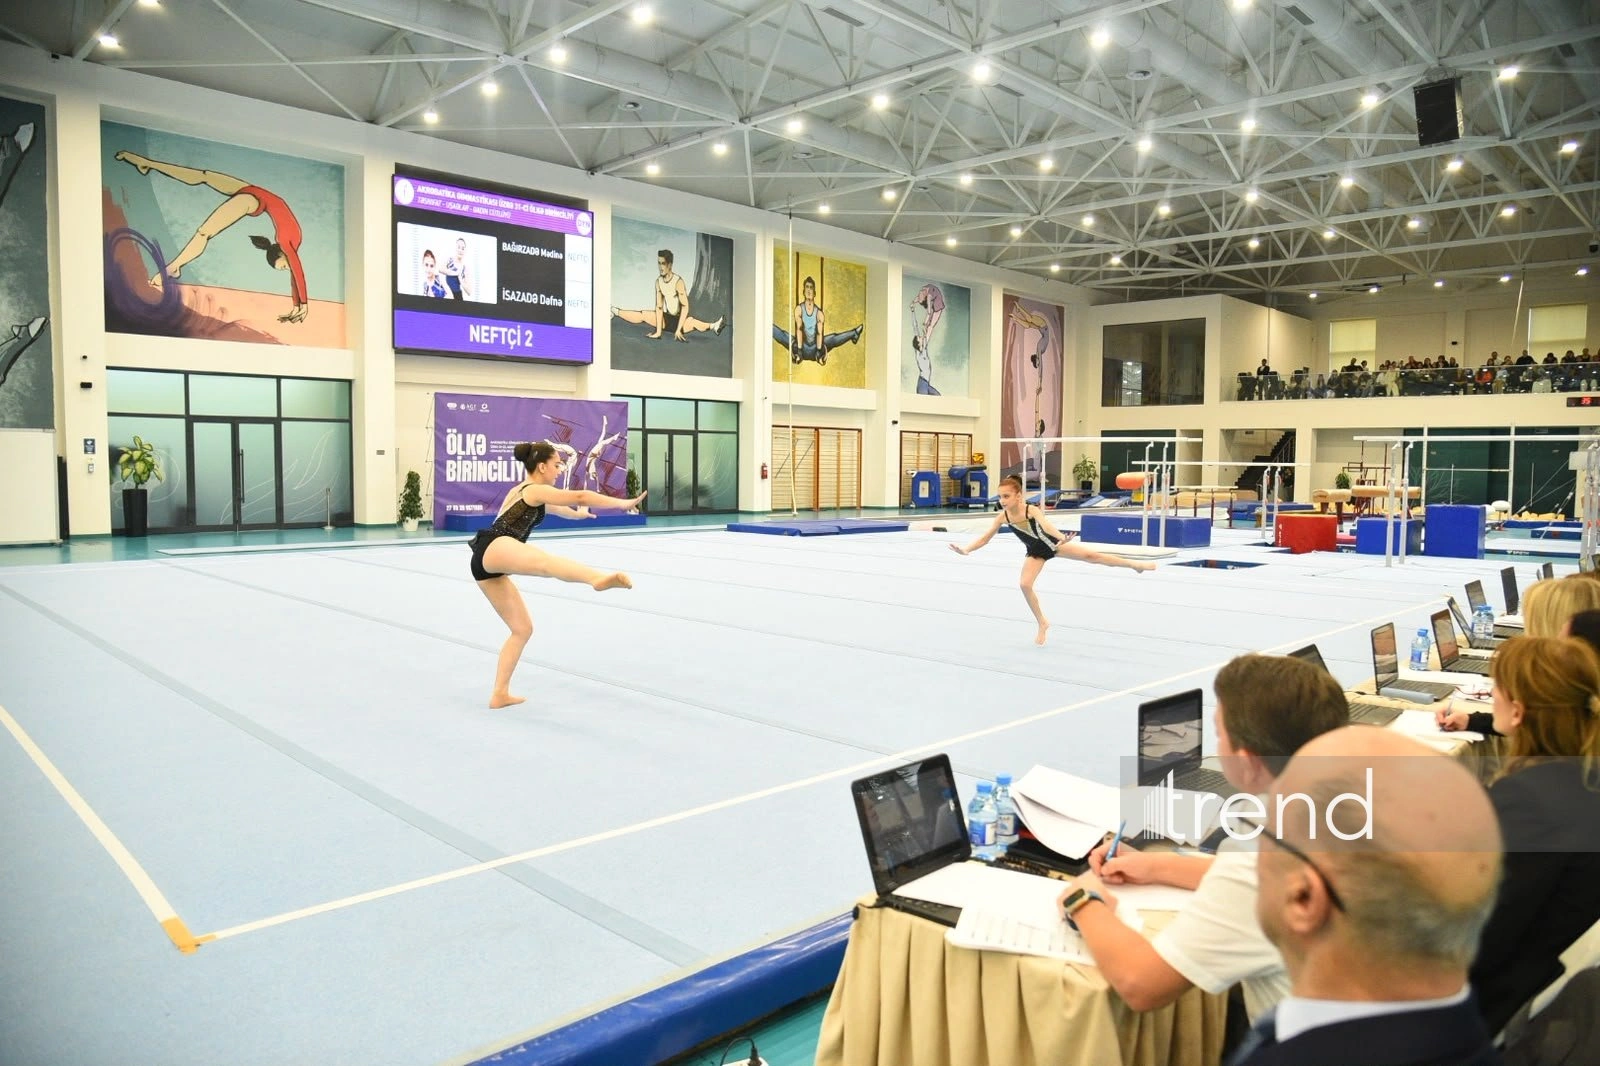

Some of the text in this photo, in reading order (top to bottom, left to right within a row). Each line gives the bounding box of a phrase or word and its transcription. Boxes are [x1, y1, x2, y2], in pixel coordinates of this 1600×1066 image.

[502, 287, 538, 304] İSAZADƏ
[469, 323, 533, 350] NEFTÇİ 2
[446, 428, 486, 456] ÖLKƏ
[446, 456, 526, 482] BİRİNCİLİY
